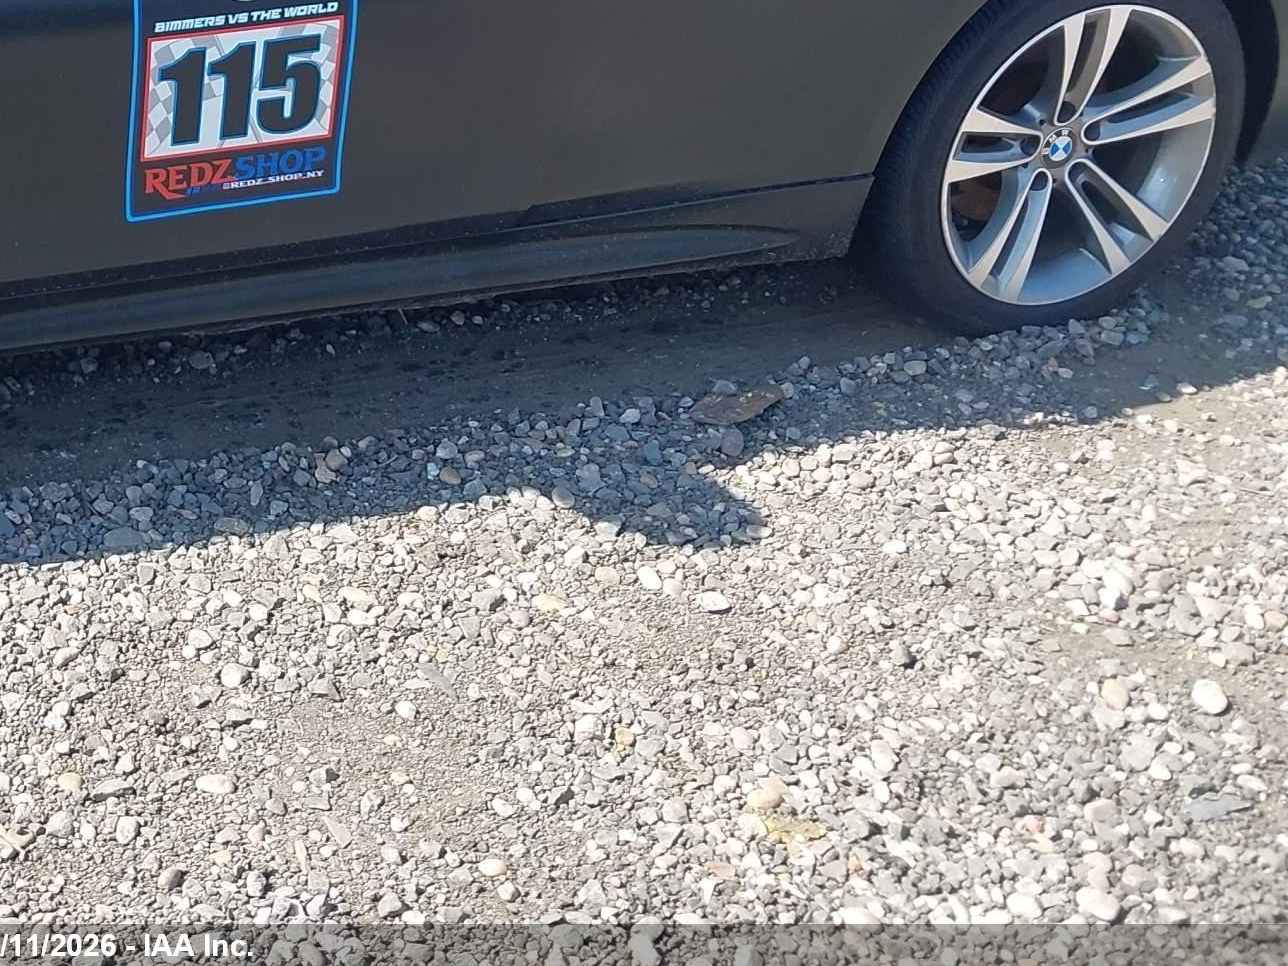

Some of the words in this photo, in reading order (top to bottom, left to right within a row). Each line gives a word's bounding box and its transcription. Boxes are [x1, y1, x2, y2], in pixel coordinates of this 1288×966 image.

[154, 14, 227, 33] BIMMERS
[228, 11, 248, 25] VS
[250, 7, 281, 22] THE
[284, 1, 339, 18] WORLD
[159, 34, 321, 146] 115
